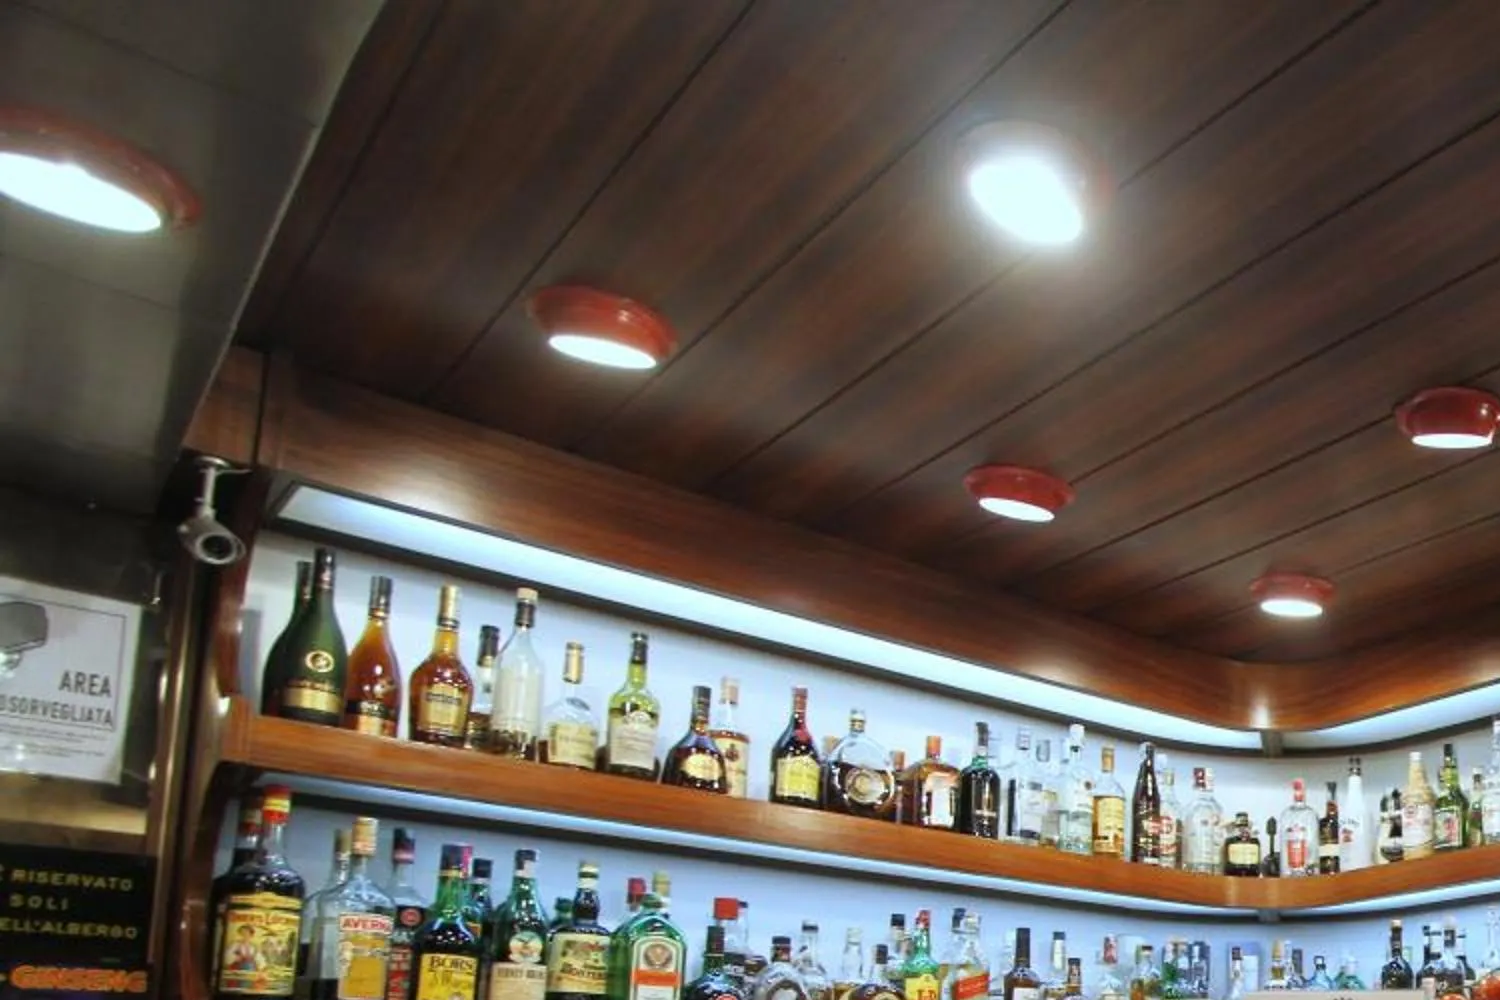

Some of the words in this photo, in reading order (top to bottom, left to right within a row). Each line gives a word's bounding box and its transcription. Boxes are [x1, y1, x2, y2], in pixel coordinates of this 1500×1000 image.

[58, 670, 112, 698] AREA
[12, 868, 133, 892] RISERVATO
[9, 893, 69, 911] SOLI
